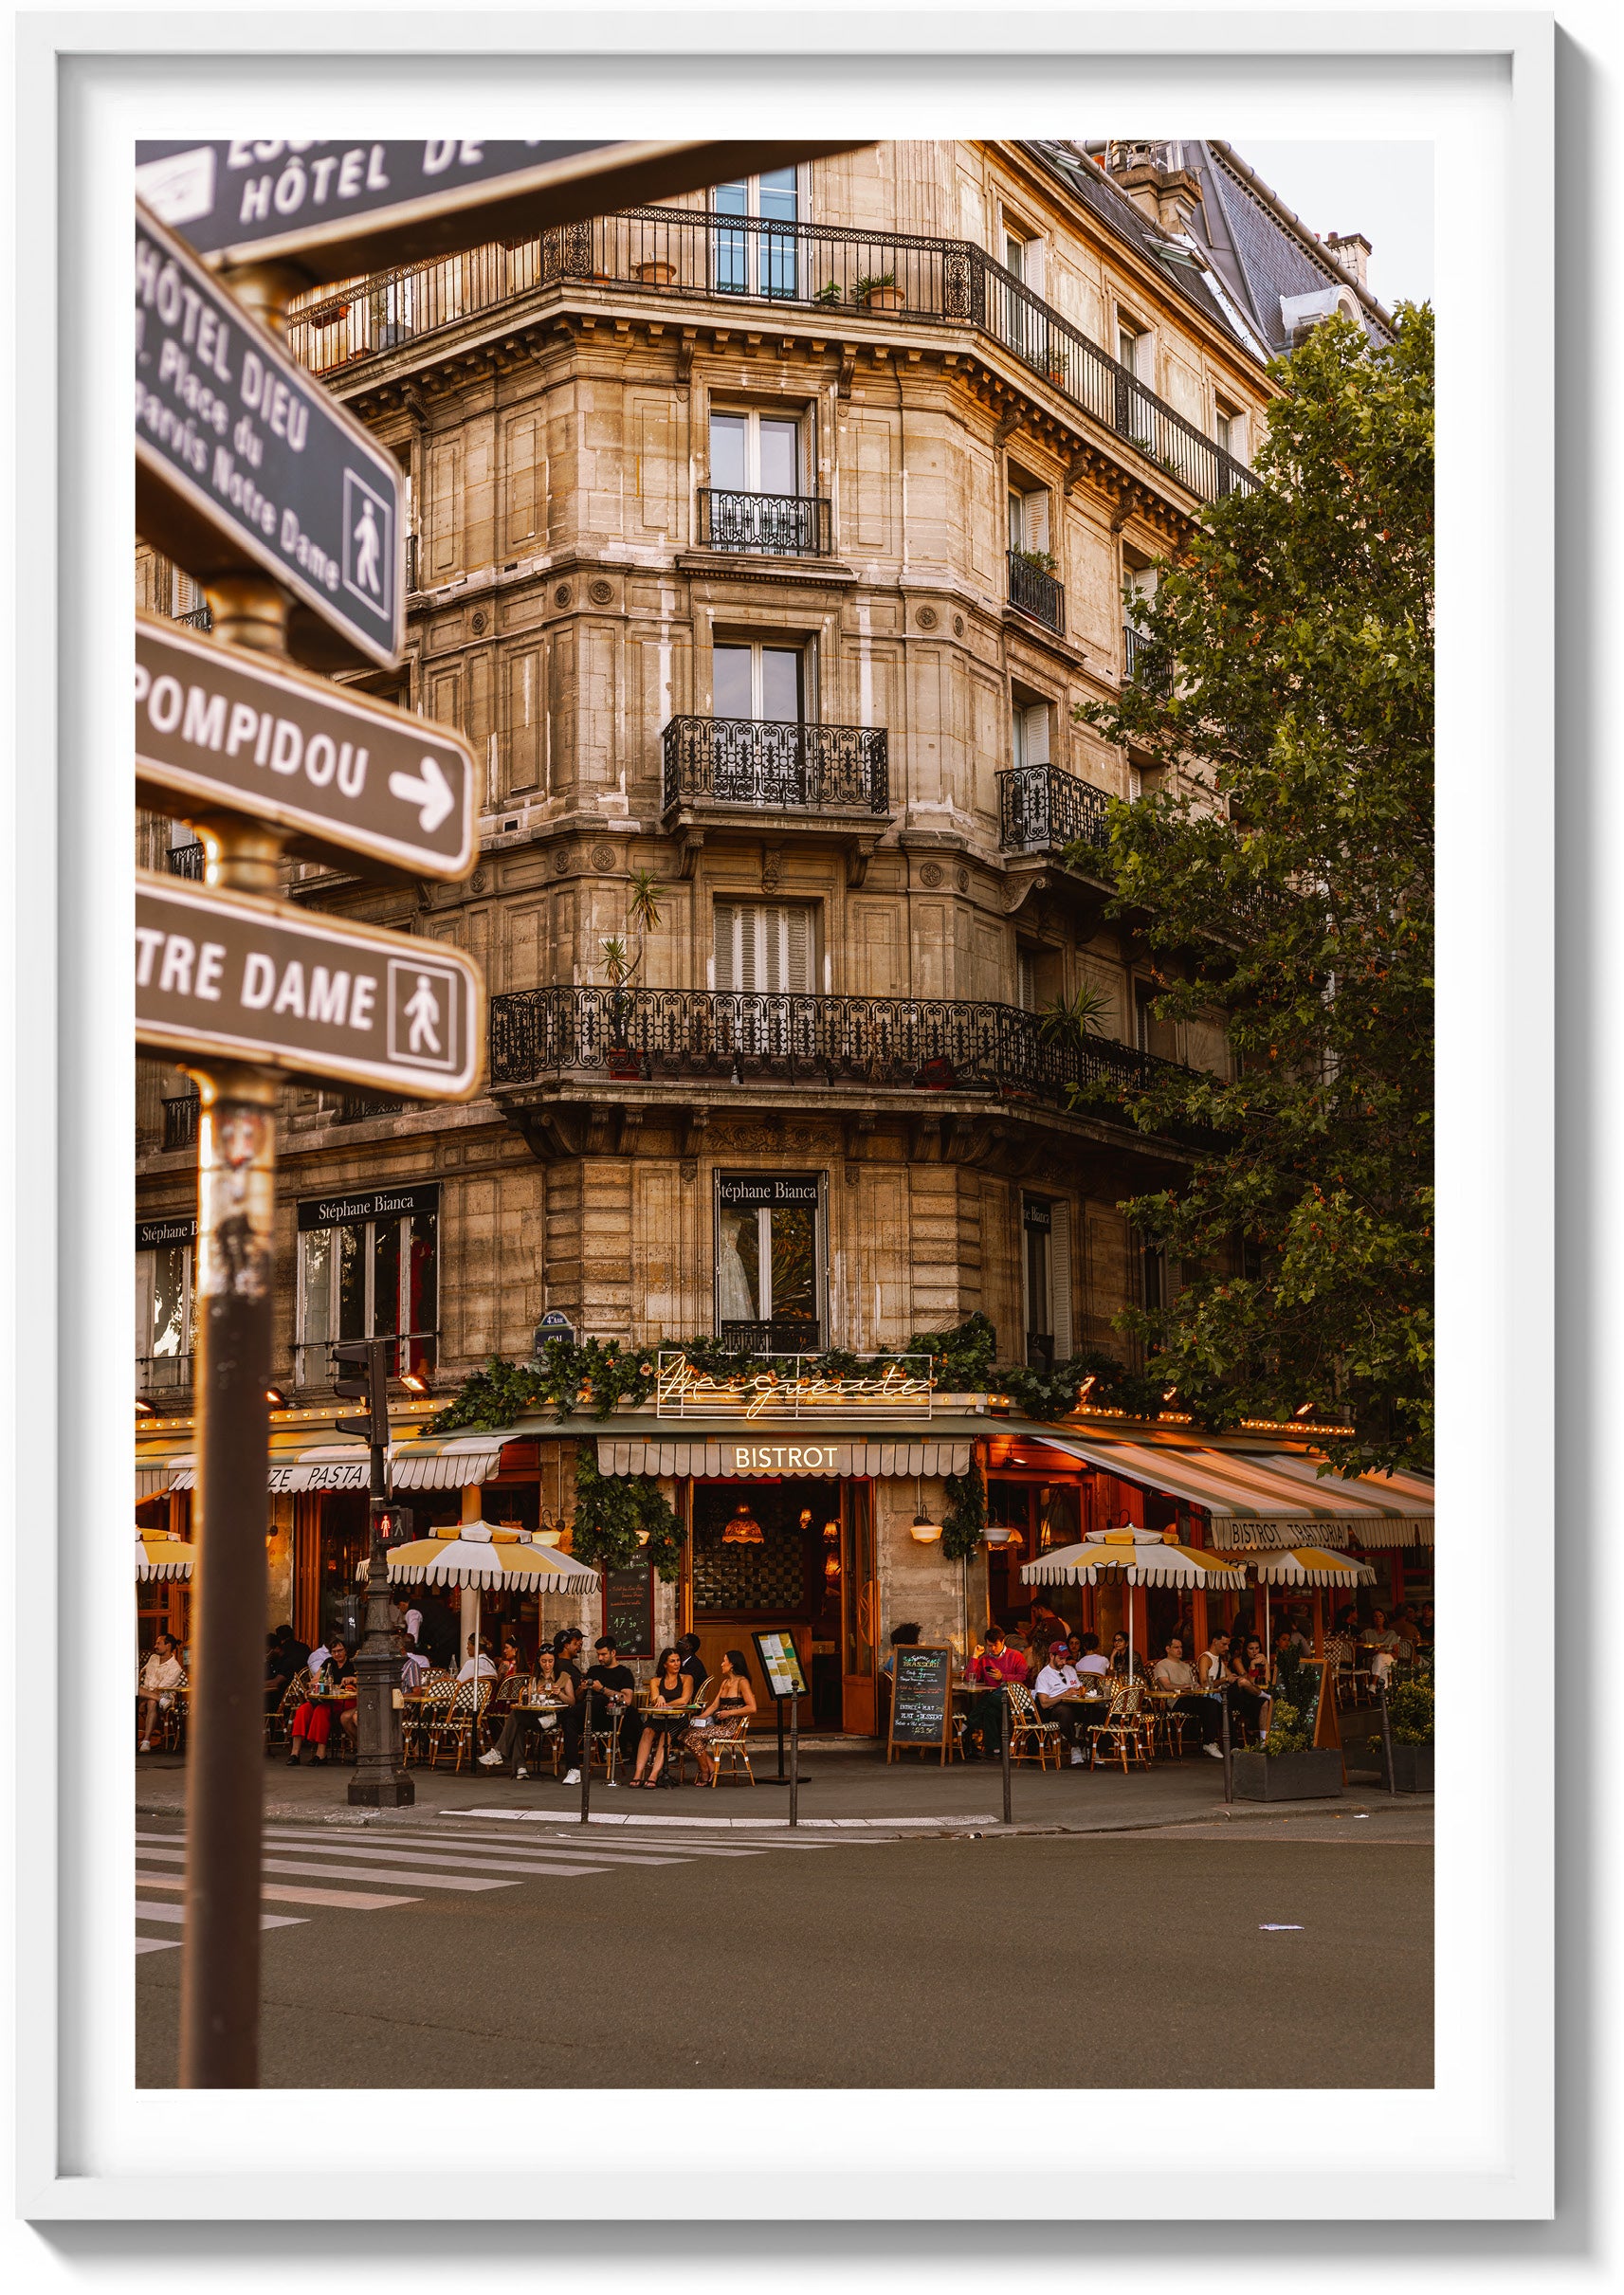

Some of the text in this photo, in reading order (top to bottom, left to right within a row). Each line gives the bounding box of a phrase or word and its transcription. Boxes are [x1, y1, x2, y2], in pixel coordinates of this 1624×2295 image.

[240, 140, 484, 225] HÔTEL DE
[136, 239, 309, 454] HÔTEL DIEU
[158, 337, 228, 437] Place
[233, 413, 263, 468] du
[212, 446, 277, 537] Notre
[281, 507, 339, 592] Dame
[241, 951, 377, 1031] DAME
[319, 1195, 414, 1221] Stéphane Bianca
[720, 1181, 817, 1202] téphane Bianca
[141, 1224, 189, 1244] Stéphane
[661, 1355, 933, 1420] Marguerite
[266, 1466, 364, 1488] ZE PASTA
[736, 1447, 838, 1468] BISTROT
[1232, 1522, 1344, 1544] BISTROT TRATTORIA
